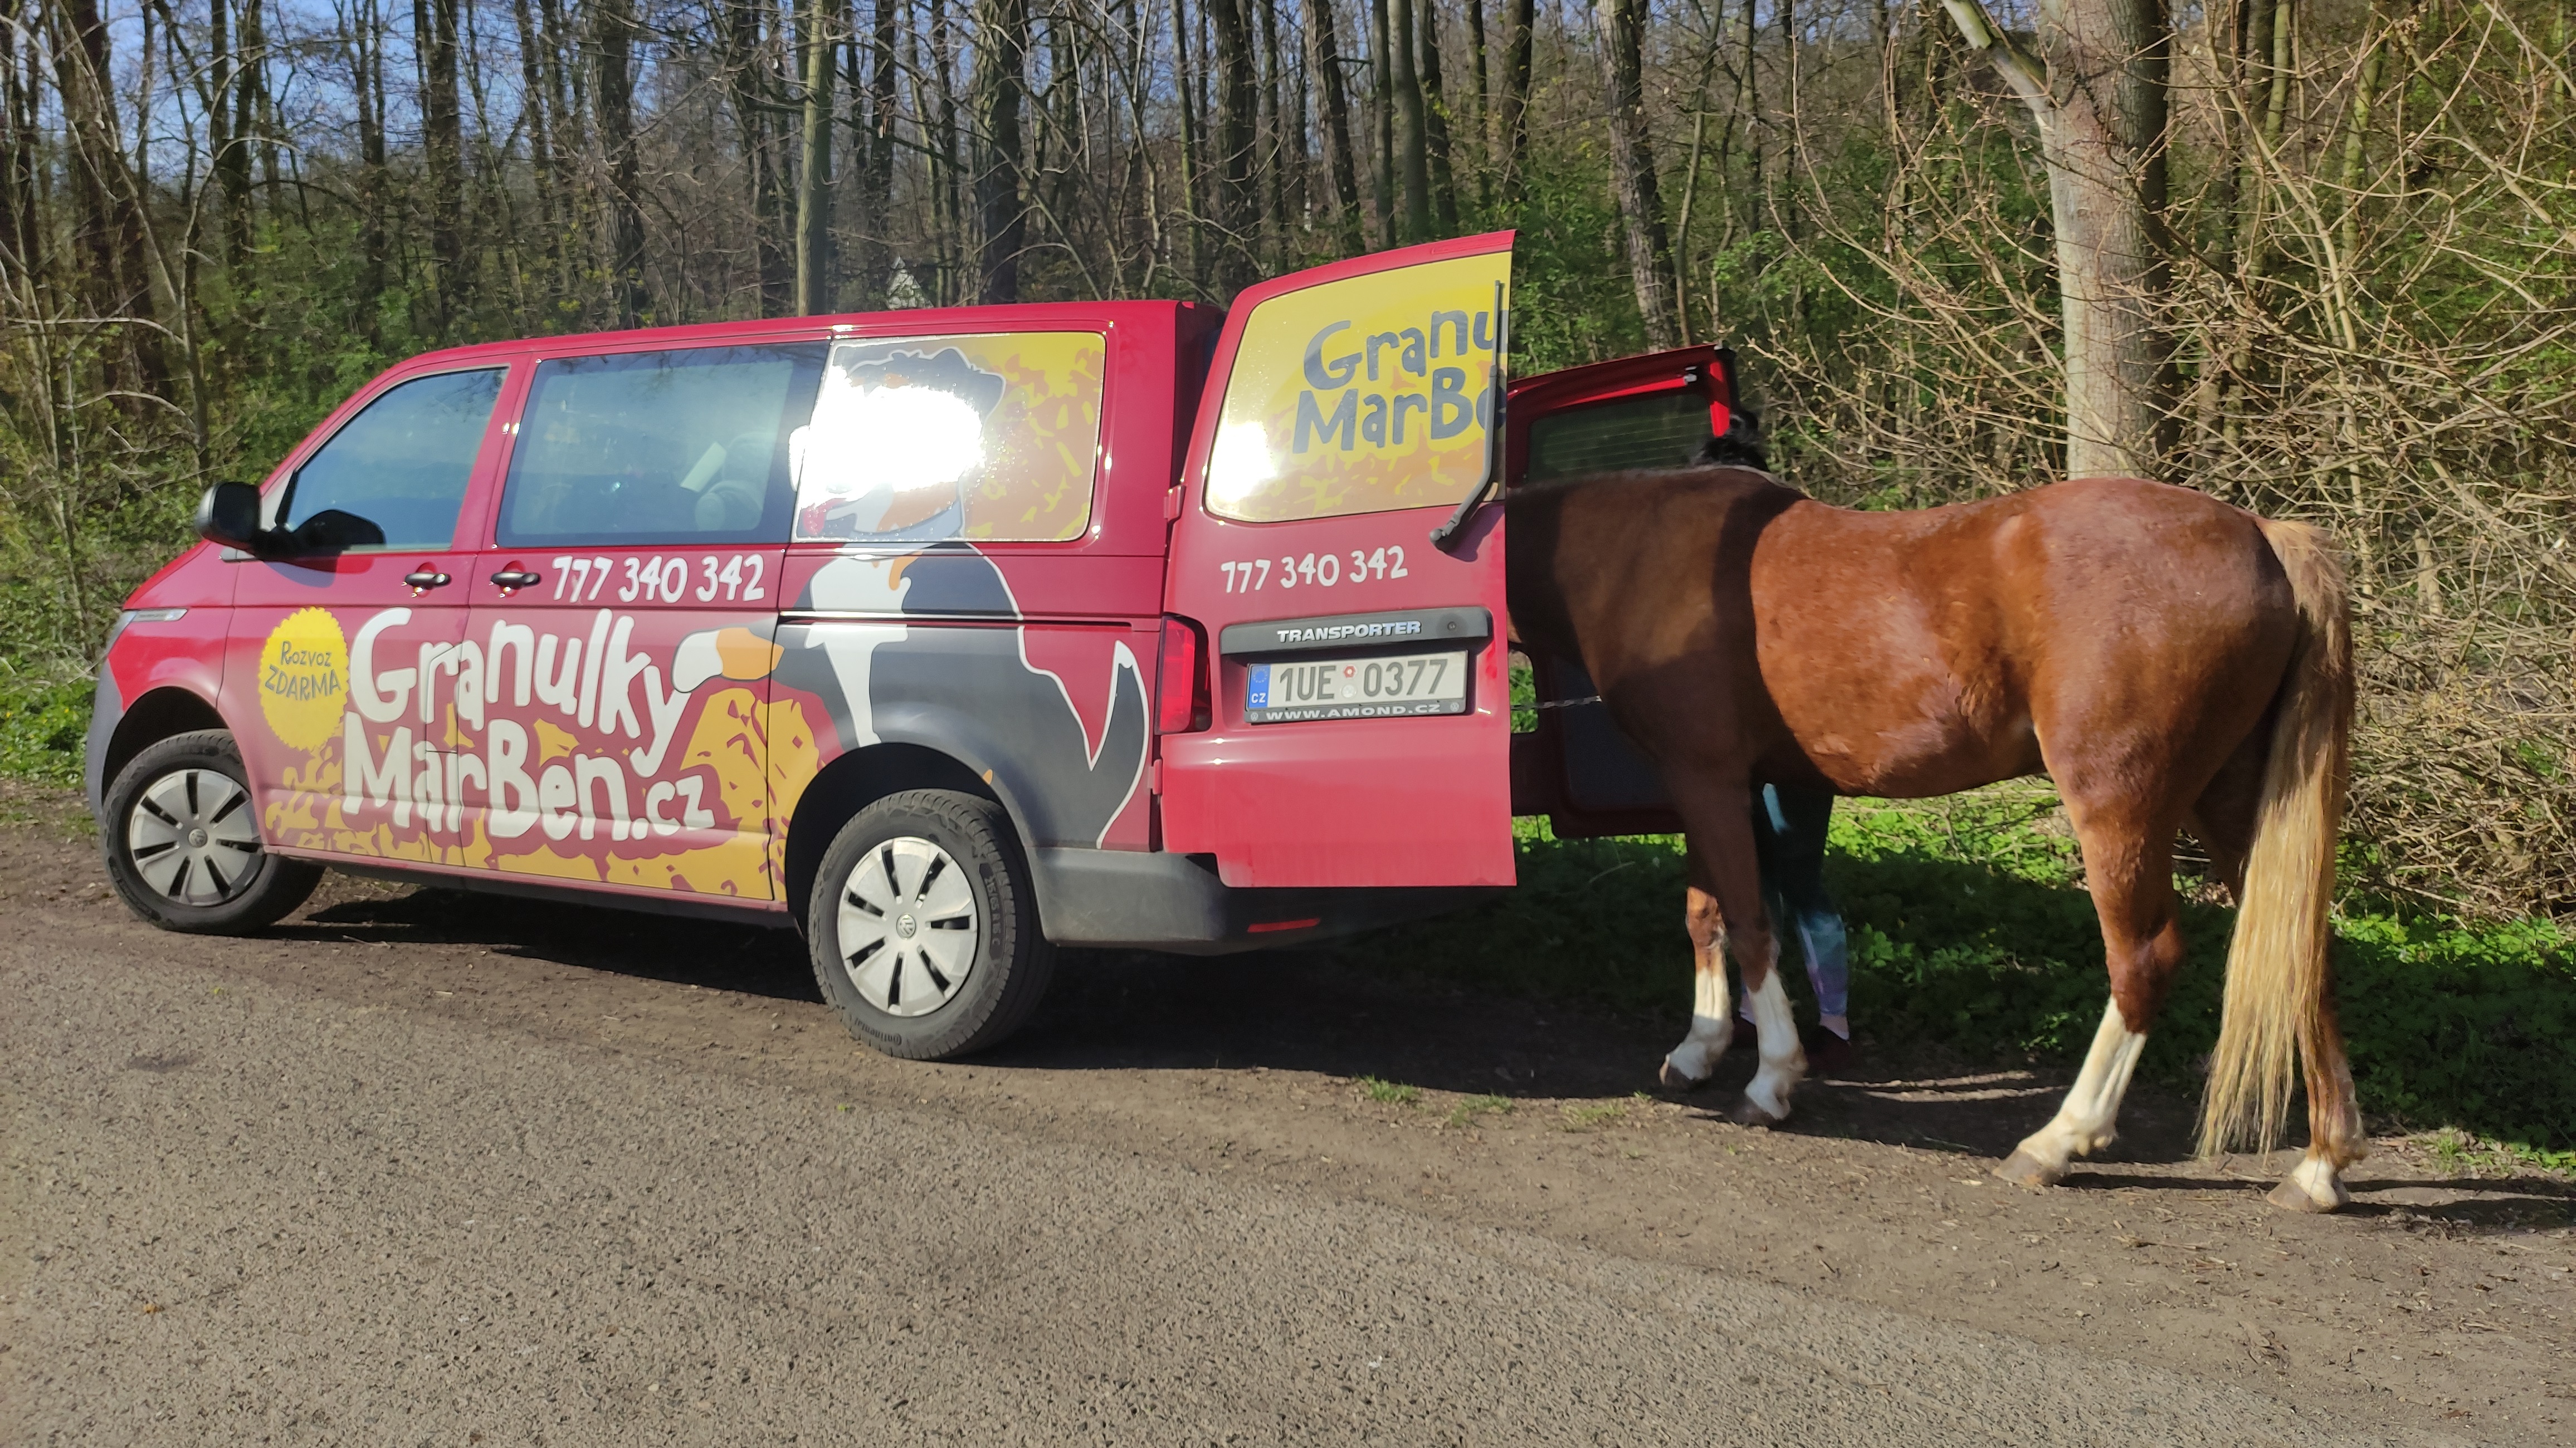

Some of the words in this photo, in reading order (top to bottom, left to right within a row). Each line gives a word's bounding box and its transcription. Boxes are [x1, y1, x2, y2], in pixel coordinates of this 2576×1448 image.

[553, 555, 613, 602] 777
[618, 556, 688, 604] 340
[696, 554, 765, 602] 342
[1221, 559, 1272, 594] 777
[1280, 552, 1341, 589] 340
[1349, 545, 1409, 584] 342
[1276, 620, 1422, 643] TRANSPORTER
[265, 664, 342, 701] ZDARMA
[350, 608, 692, 778] Granulky
[1251, 692, 1266, 705] CZ
[1280, 665, 1336, 703] 1UE
[1363, 659, 1449, 697] 0377
[1265, 703, 1442, 722] WWW.AMOND.CZ
[341, 711, 715, 841] MarBen.cz
